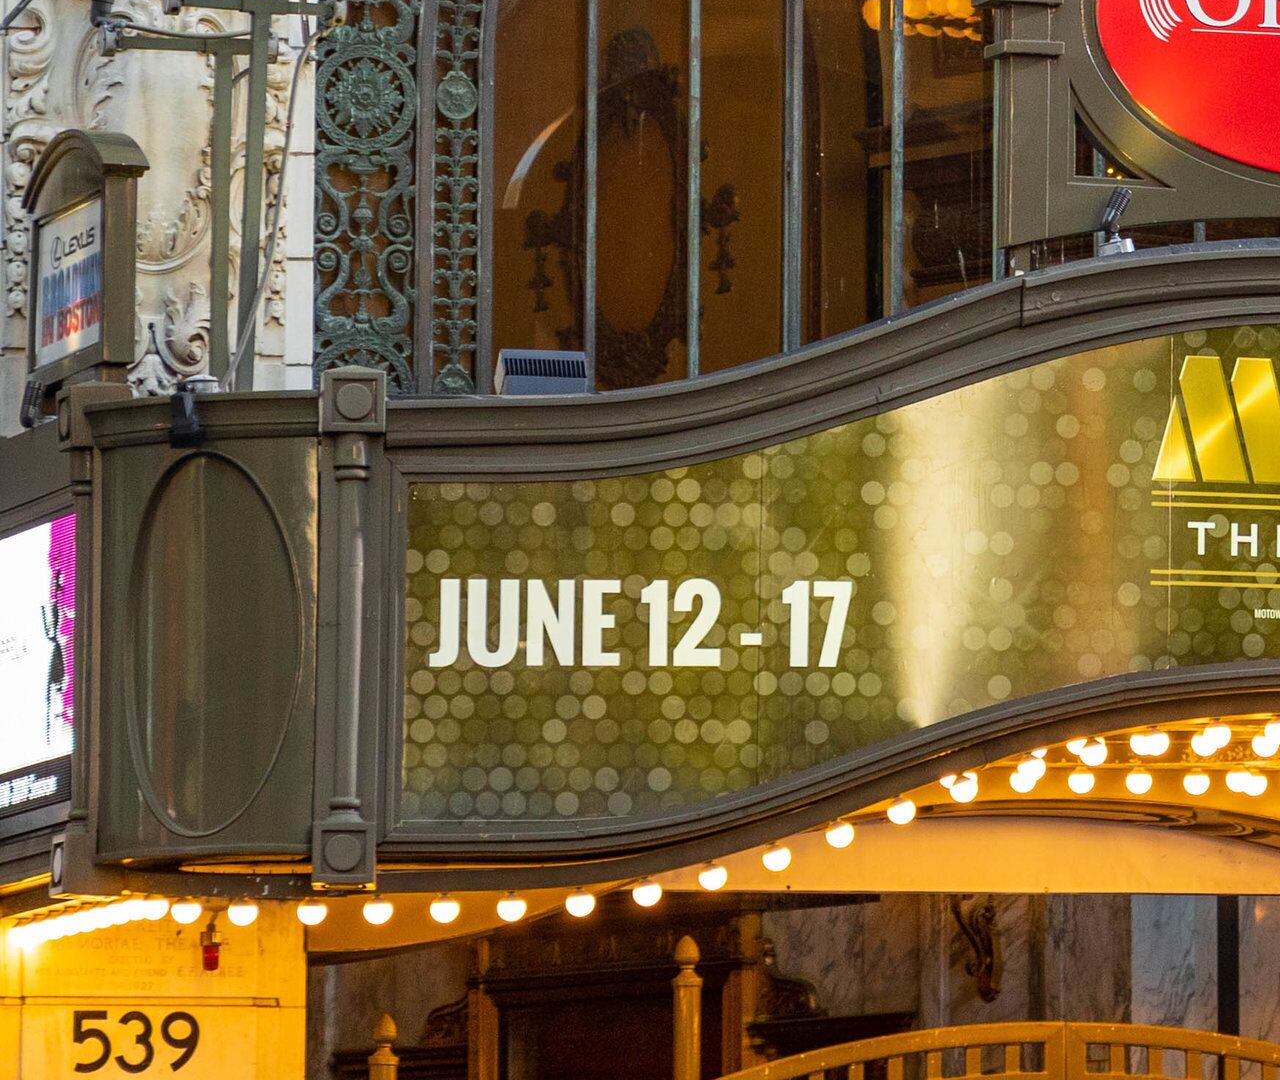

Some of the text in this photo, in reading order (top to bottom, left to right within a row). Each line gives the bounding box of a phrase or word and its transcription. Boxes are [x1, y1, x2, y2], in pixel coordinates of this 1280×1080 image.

[63, 226, 95, 258] LEXUS
[428, 578, 621, 668] JUNE
[72, 1010, 201, 1074] 539
